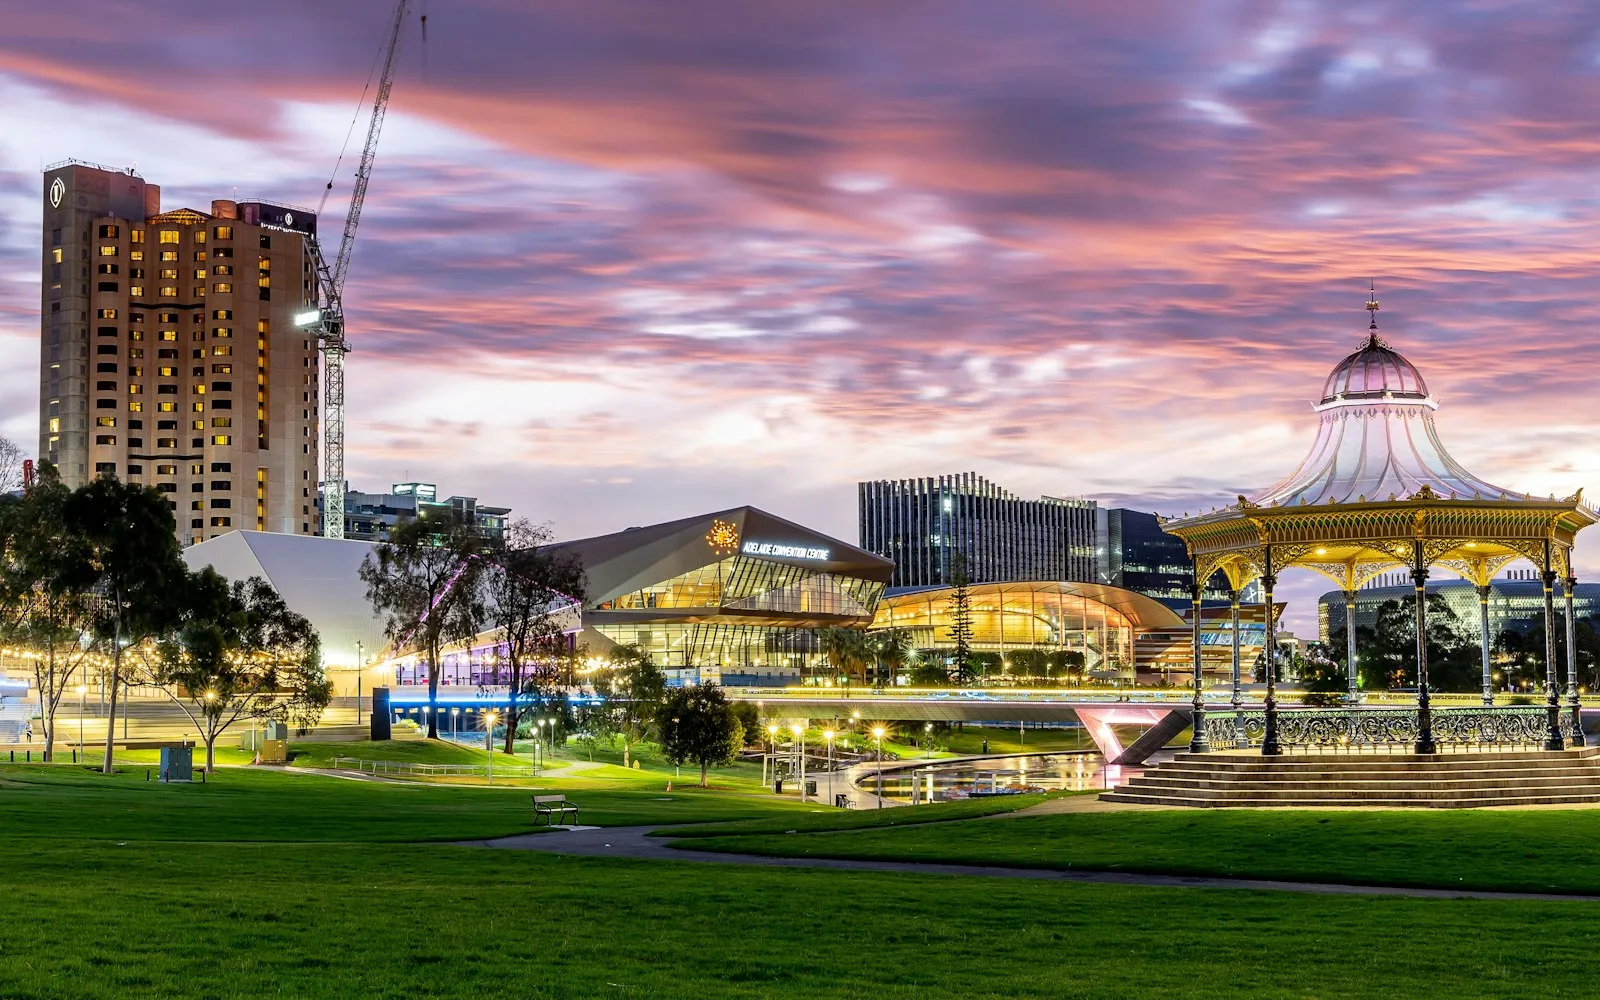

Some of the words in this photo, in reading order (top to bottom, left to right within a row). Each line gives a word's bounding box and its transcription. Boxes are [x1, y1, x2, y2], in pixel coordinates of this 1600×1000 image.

[743, 542, 772, 555] ADELAIDE
[772, 545, 807, 558] CONVENTION
[807, 548, 829, 560] CENTRE
